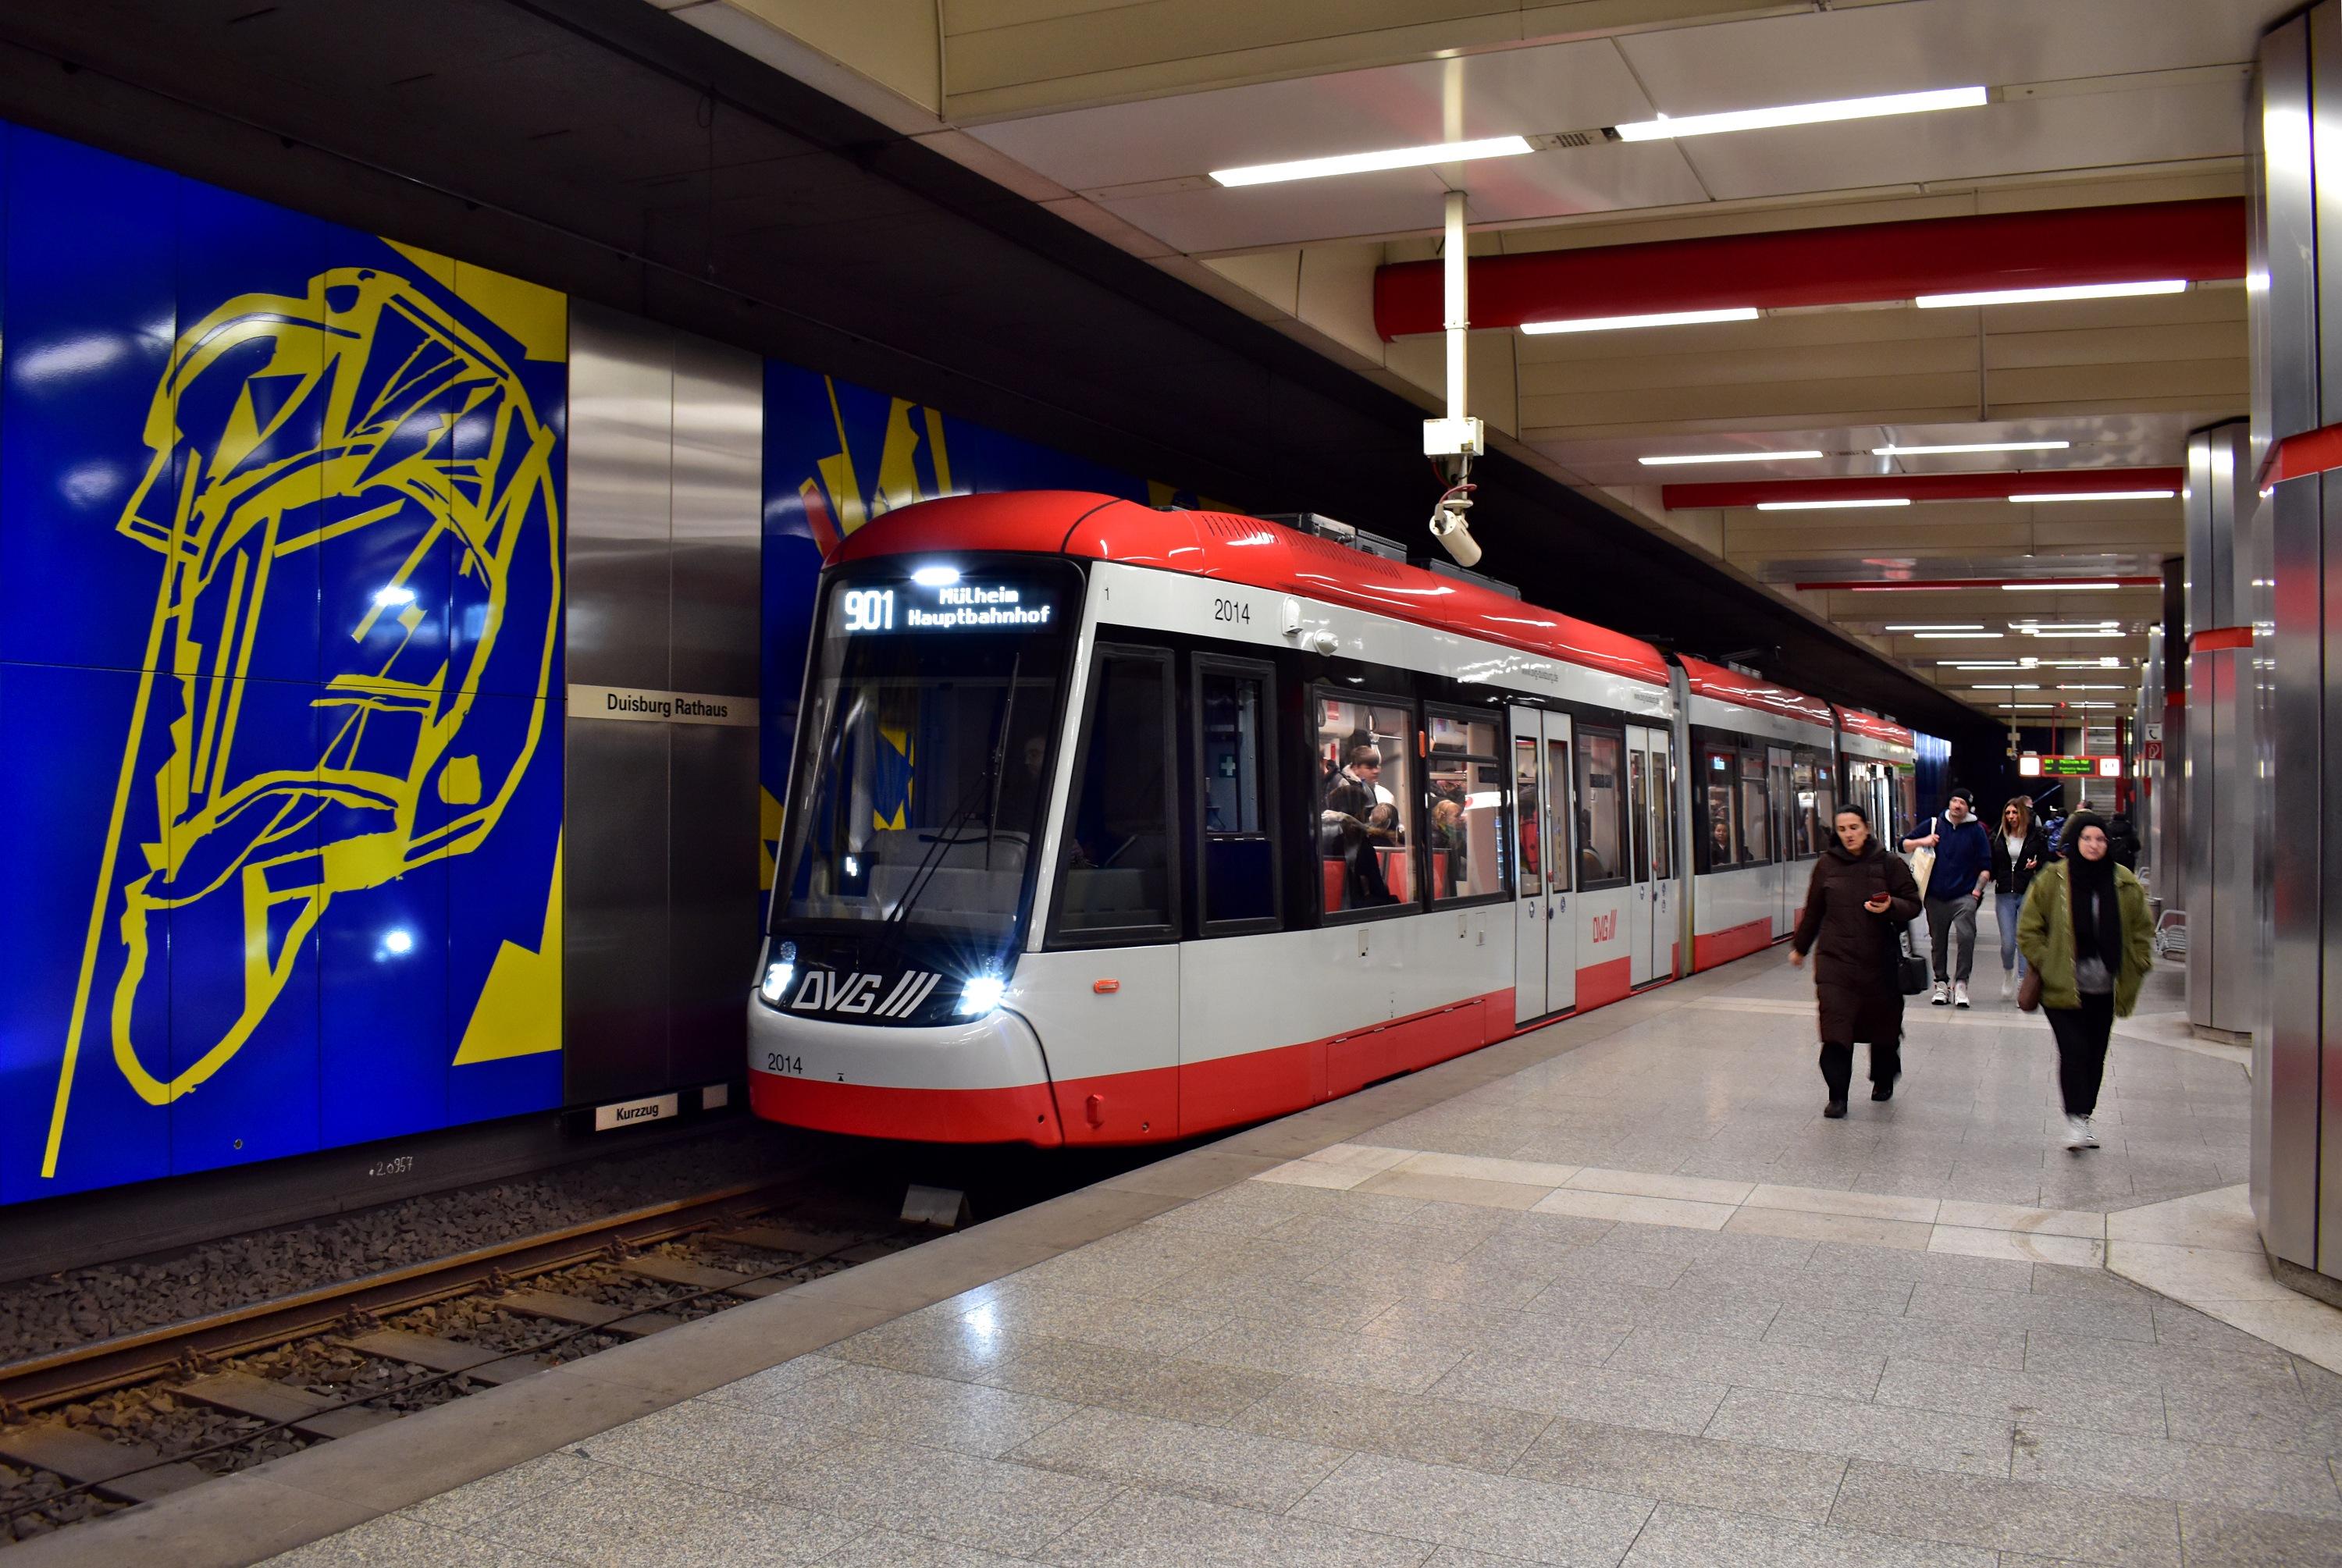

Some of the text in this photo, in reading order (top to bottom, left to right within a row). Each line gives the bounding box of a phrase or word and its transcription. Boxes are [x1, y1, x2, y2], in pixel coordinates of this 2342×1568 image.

[939, 586, 1019, 605] Mülheim
[1105, 587, 1110, 601] 1
[845, 590, 894, 631] 901
[908, 606, 1051, 628] Hauptbahnhof
[1215, 598, 1251, 625] 2014
[607, 693, 728, 718] Duisburg Rathaus
[768, 1052, 803, 1075] 2014
[616, 1104, 659, 1122] Kurzzug
